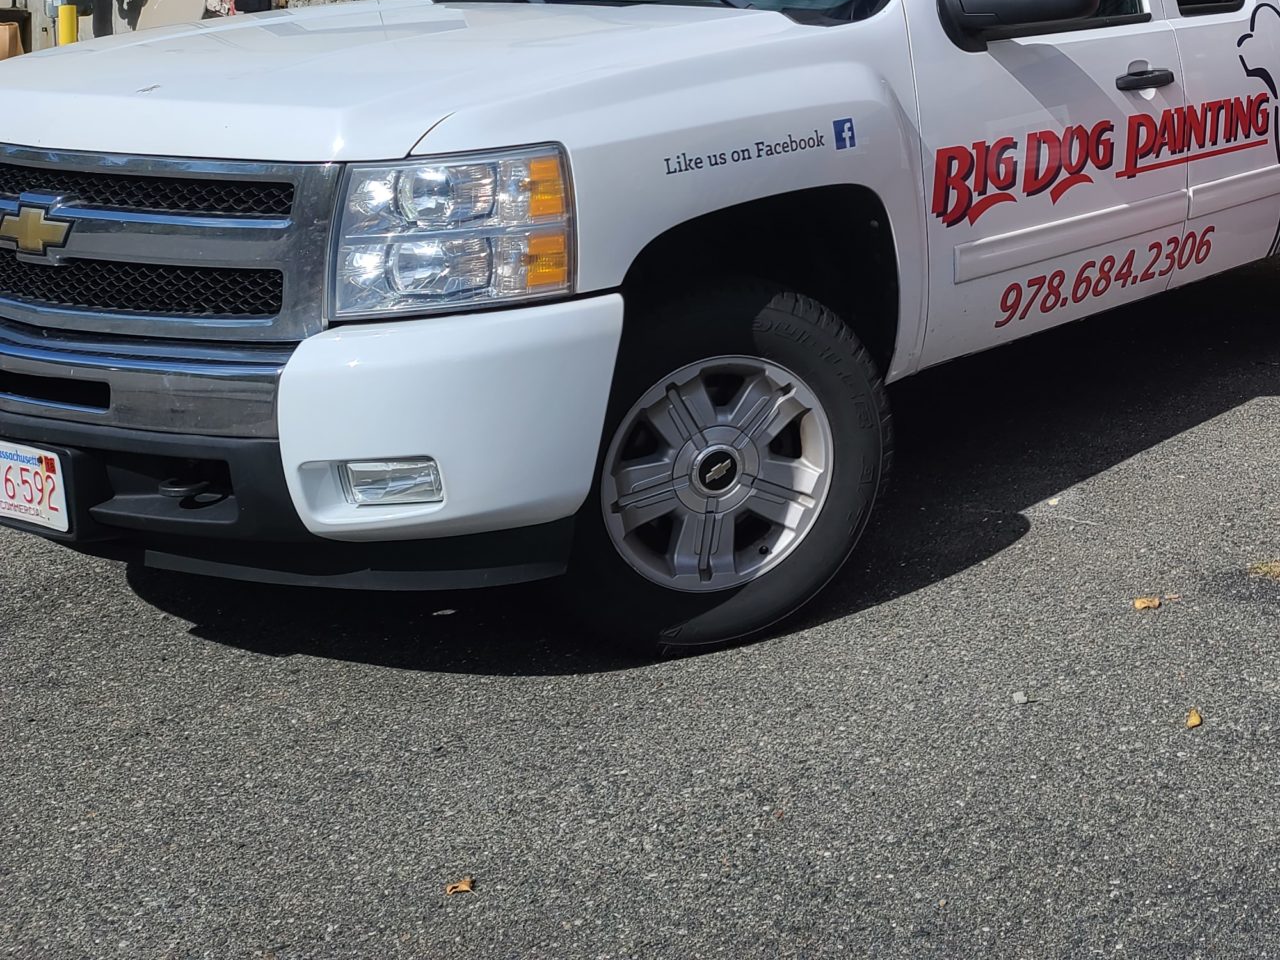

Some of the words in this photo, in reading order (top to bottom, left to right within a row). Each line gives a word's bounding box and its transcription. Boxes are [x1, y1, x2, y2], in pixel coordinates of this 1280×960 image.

[664, 152, 704, 175] Like
[707, 152, 727, 167] us
[731, 147, 752, 163] on
[755, 129, 826, 158] Facebook
[931, 136, 1018, 228] BIG
[1022, 120, 1114, 202] DOG
[1122, 92, 1270, 180] PAINTING
[994, 225, 1215, 328] 978.684.2306
